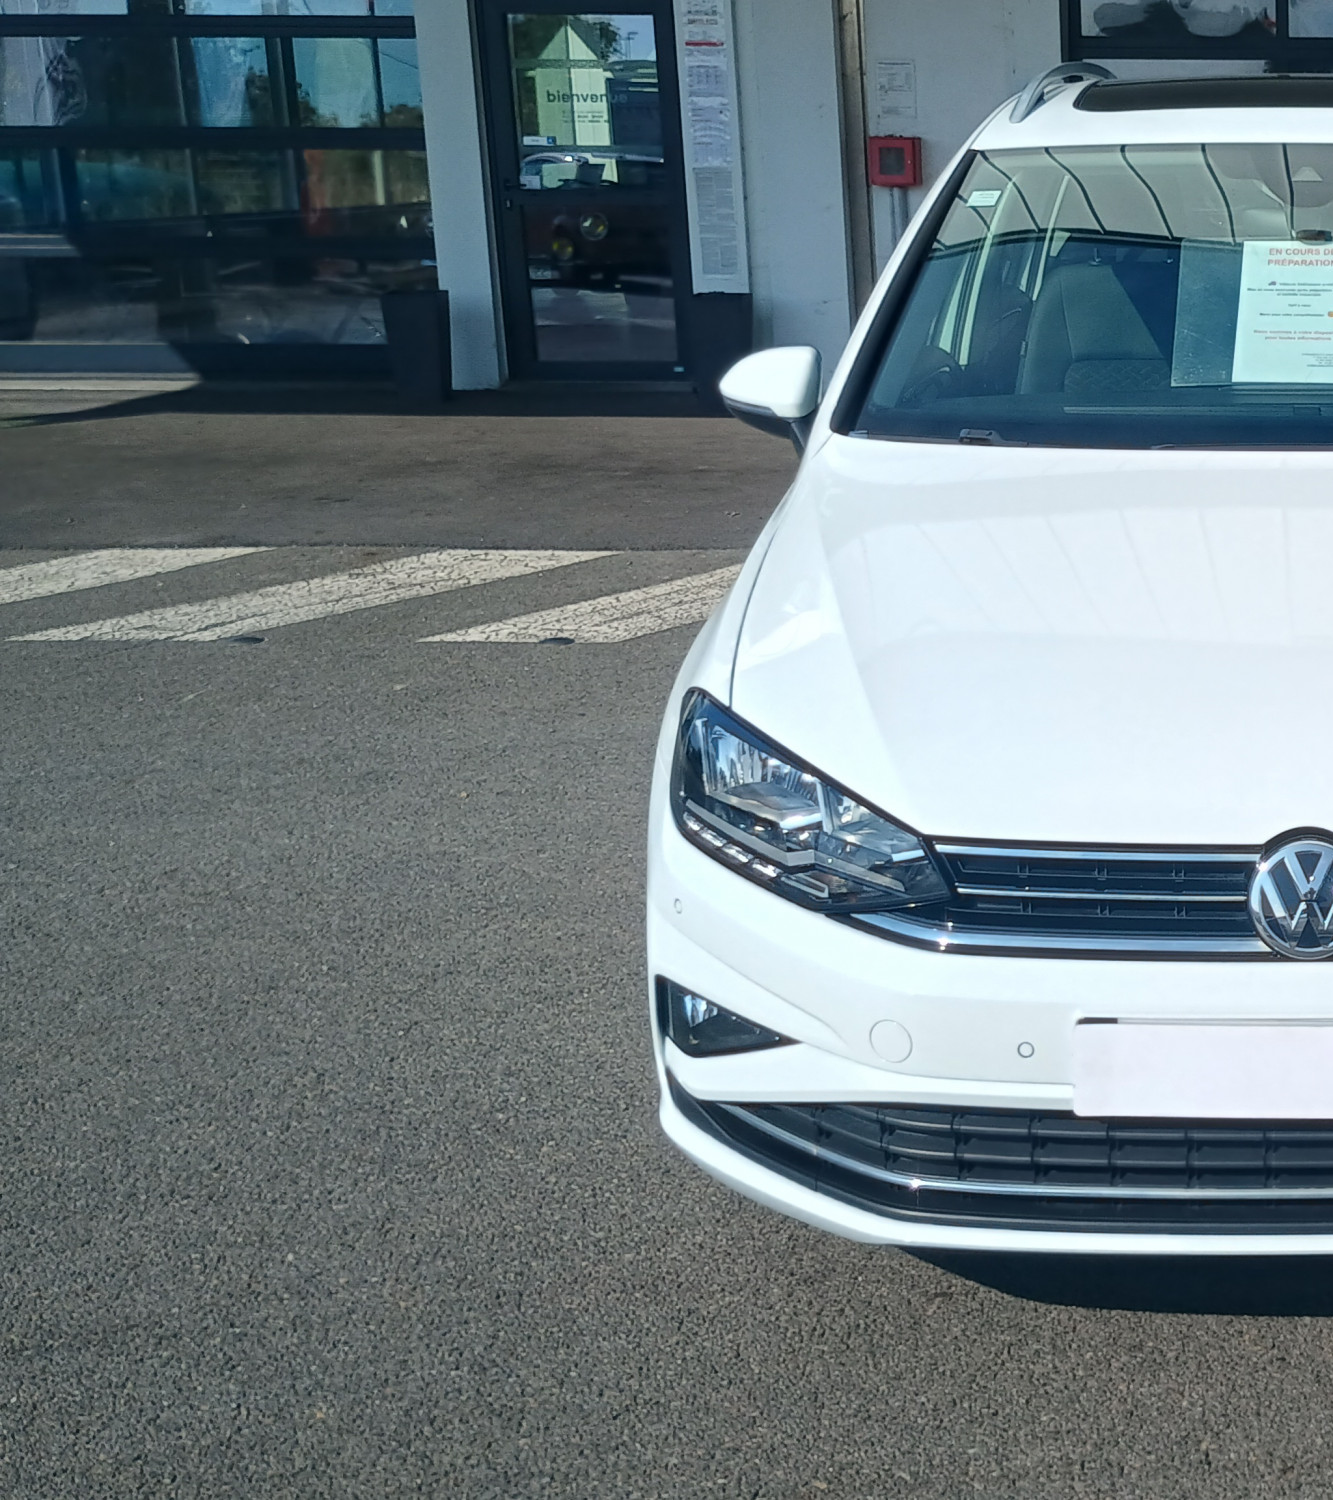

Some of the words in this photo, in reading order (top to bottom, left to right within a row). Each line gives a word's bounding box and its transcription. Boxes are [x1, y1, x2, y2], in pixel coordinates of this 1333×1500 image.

[547, 89, 628, 103] bienvenue
[1269, 248, 1283, 256] EN
[1285, 248, 1321, 256] COURS
